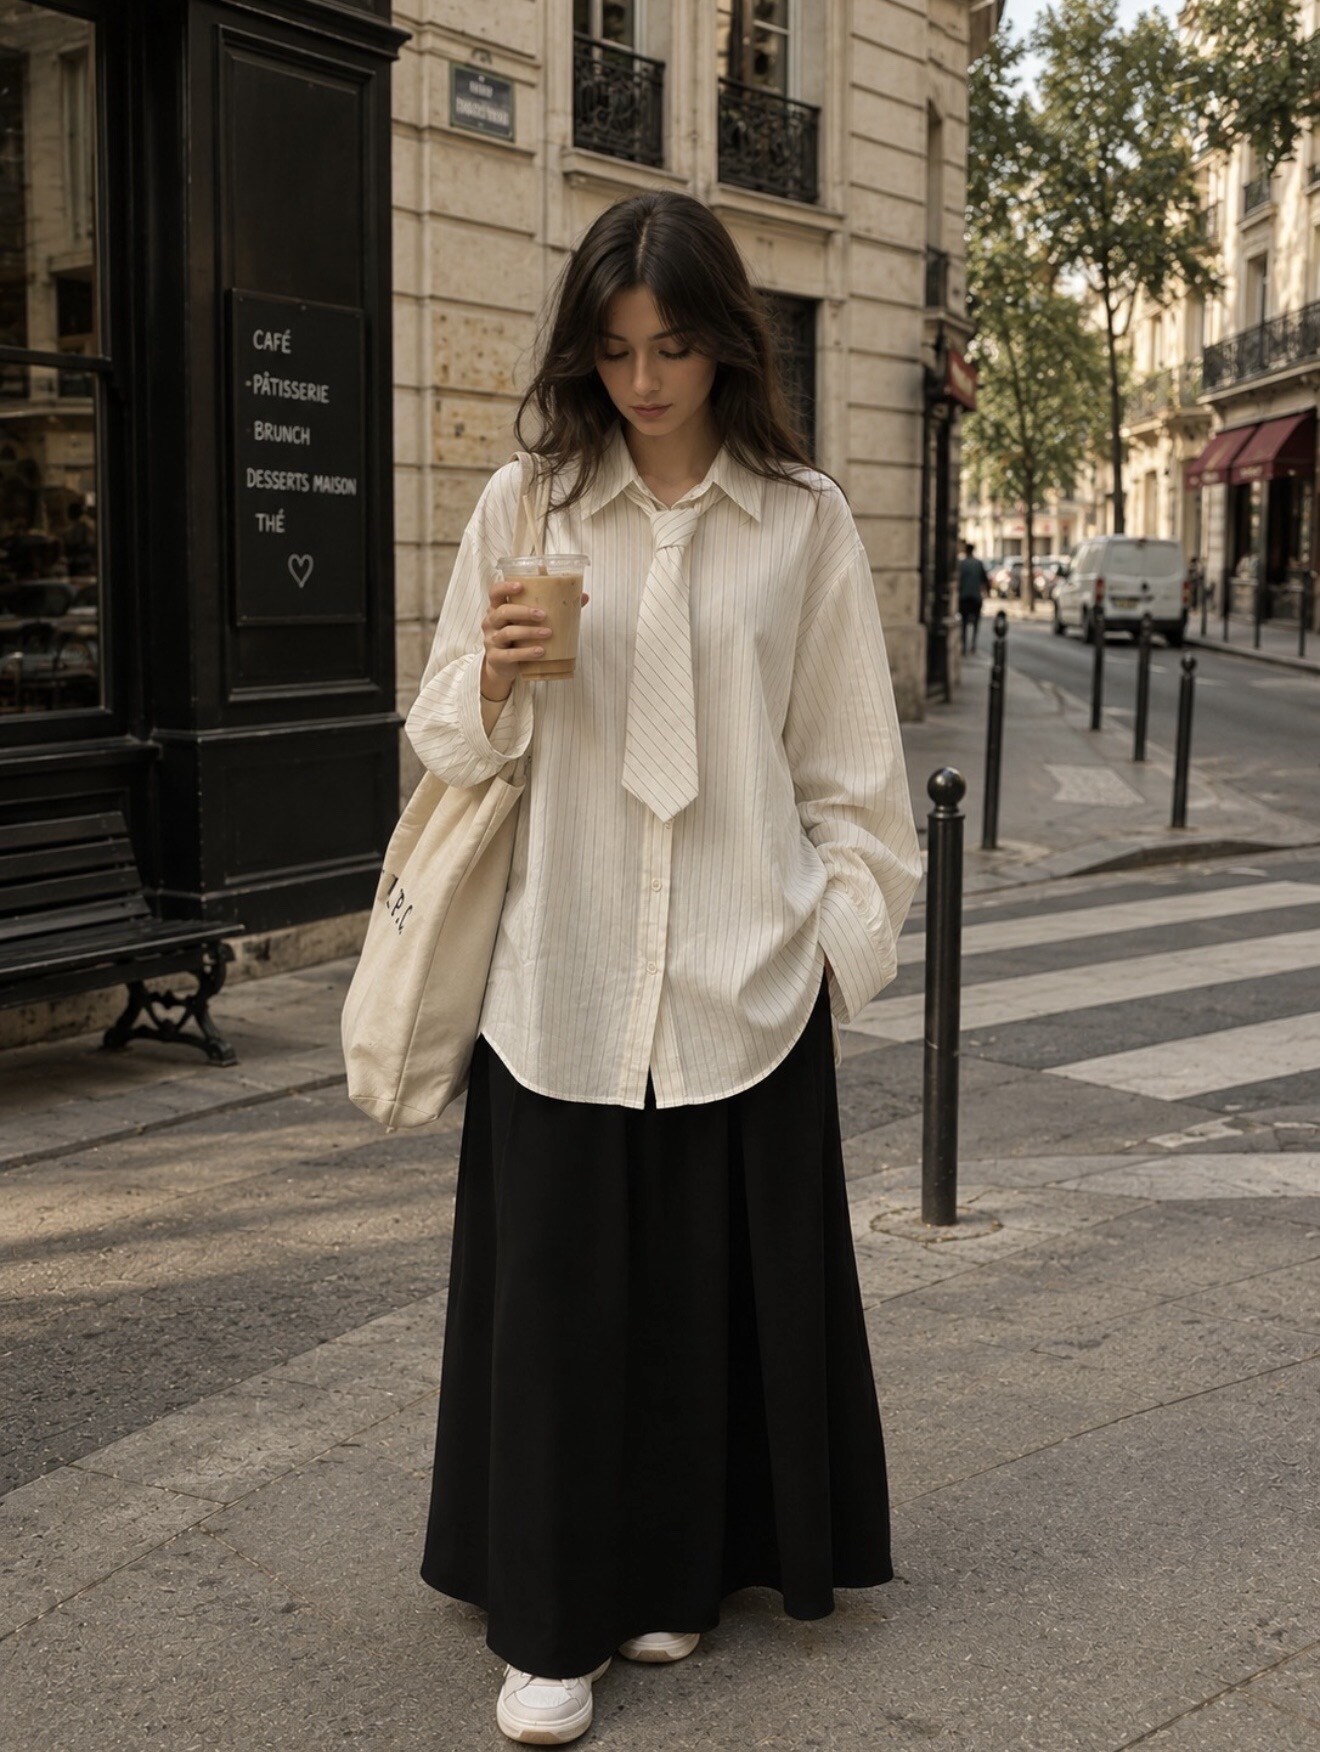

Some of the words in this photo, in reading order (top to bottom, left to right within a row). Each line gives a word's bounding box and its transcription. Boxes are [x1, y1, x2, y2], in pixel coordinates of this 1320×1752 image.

[253, 329, 291, 354] CAFÉ
[254, 420, 310, 445] BRUNCH
[247, 467, 309, 492] DESSERTS
[313, 475, 357, 496] MAISON
[255, 508, 285, 533] THÉ
